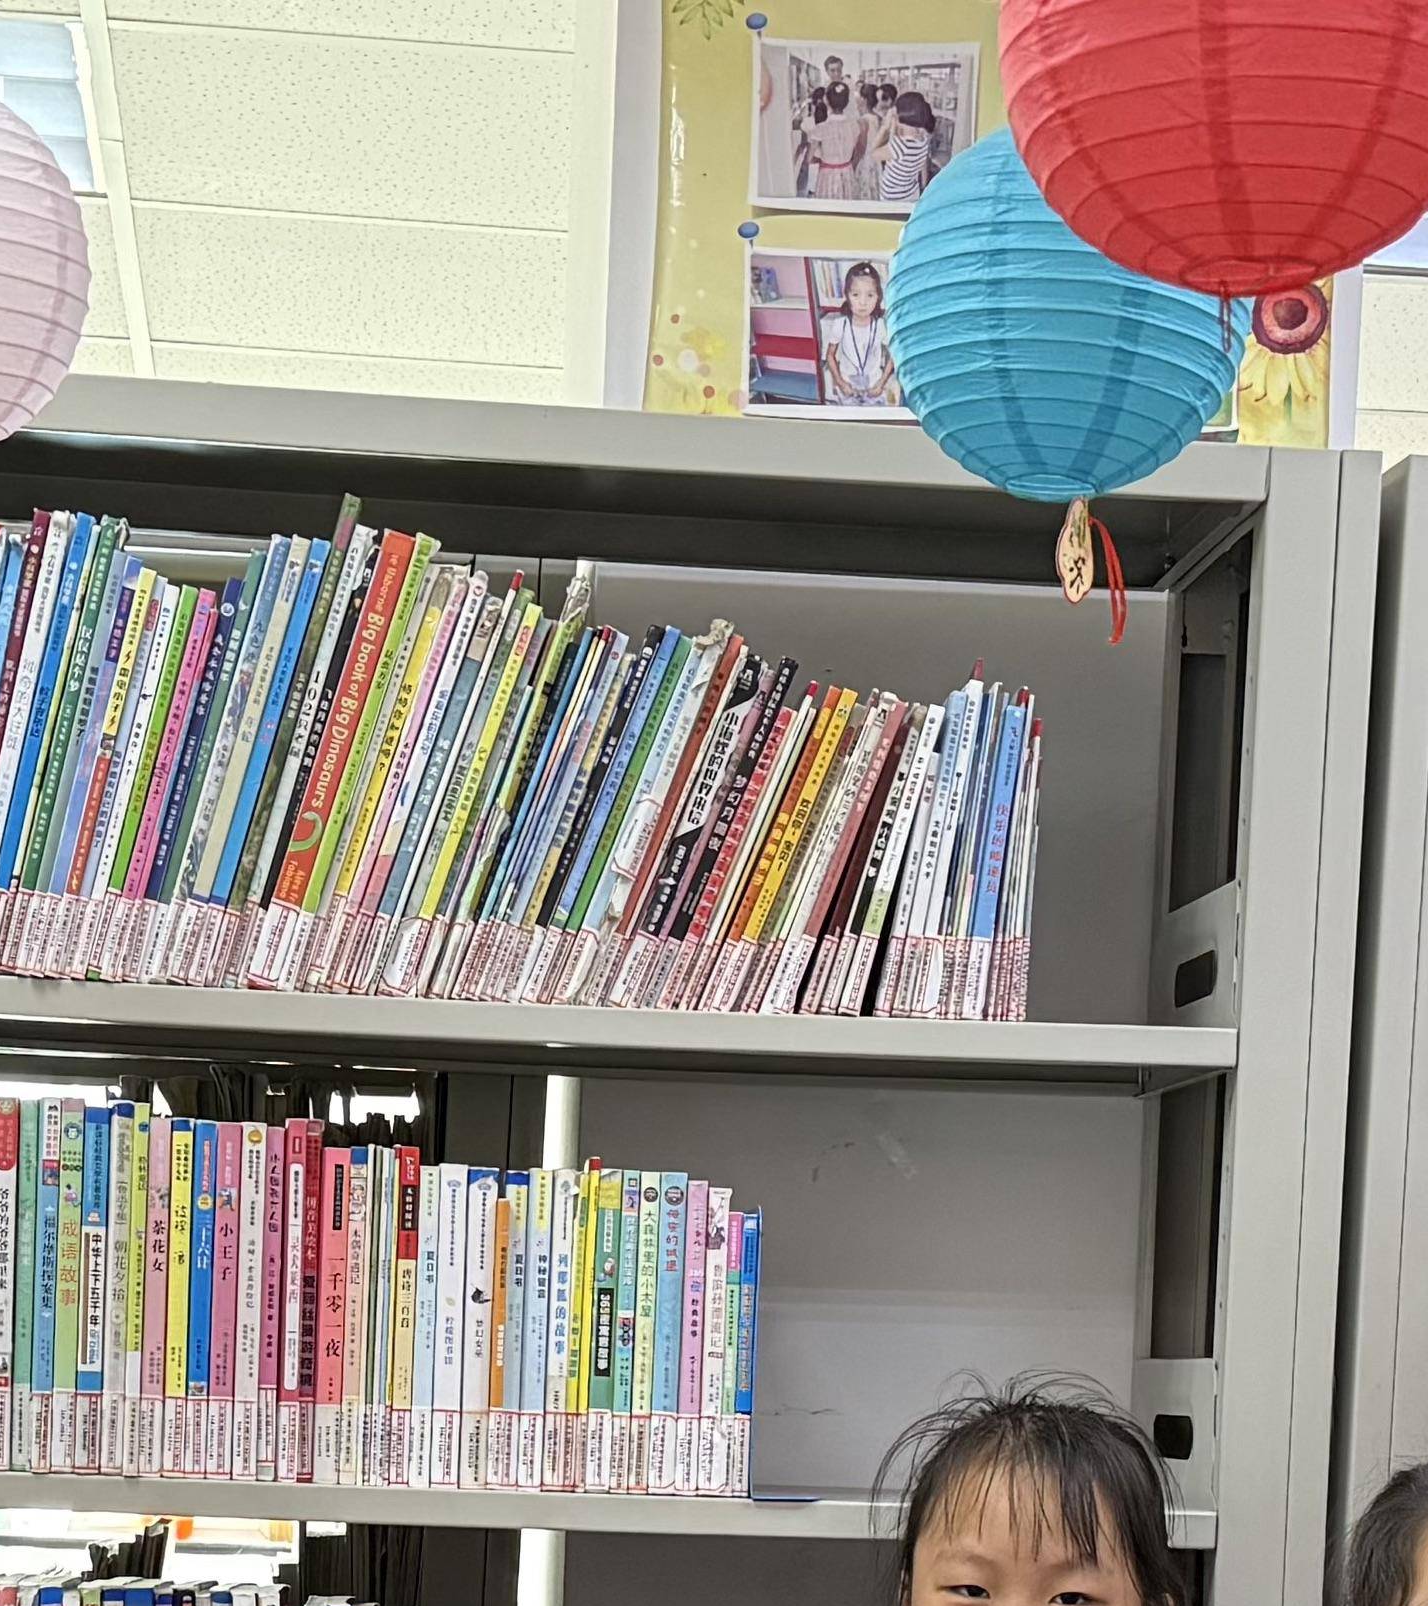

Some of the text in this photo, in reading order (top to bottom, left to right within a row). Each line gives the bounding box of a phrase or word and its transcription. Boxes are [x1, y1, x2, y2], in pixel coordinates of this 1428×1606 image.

[367, 612, 385, 643] Big
[348, 681, 360, 698] of
[351, 644, 372, 682] book
[335, 696, 360, 727] Big
[310, 724, 349, 808] Dinosaurs
[59, 1218, 78, 1308] 成语故事
[151, 1219, 167, 1273] 茶花女
[218, 1222, 234, 1282] 小王子
[640, 1209, 657, 1317] 大森林里的小木屋
[88, 1232, 102, 1327] 中华上下五千年
[324, 1256, 346, 1359] 一千零一夜
